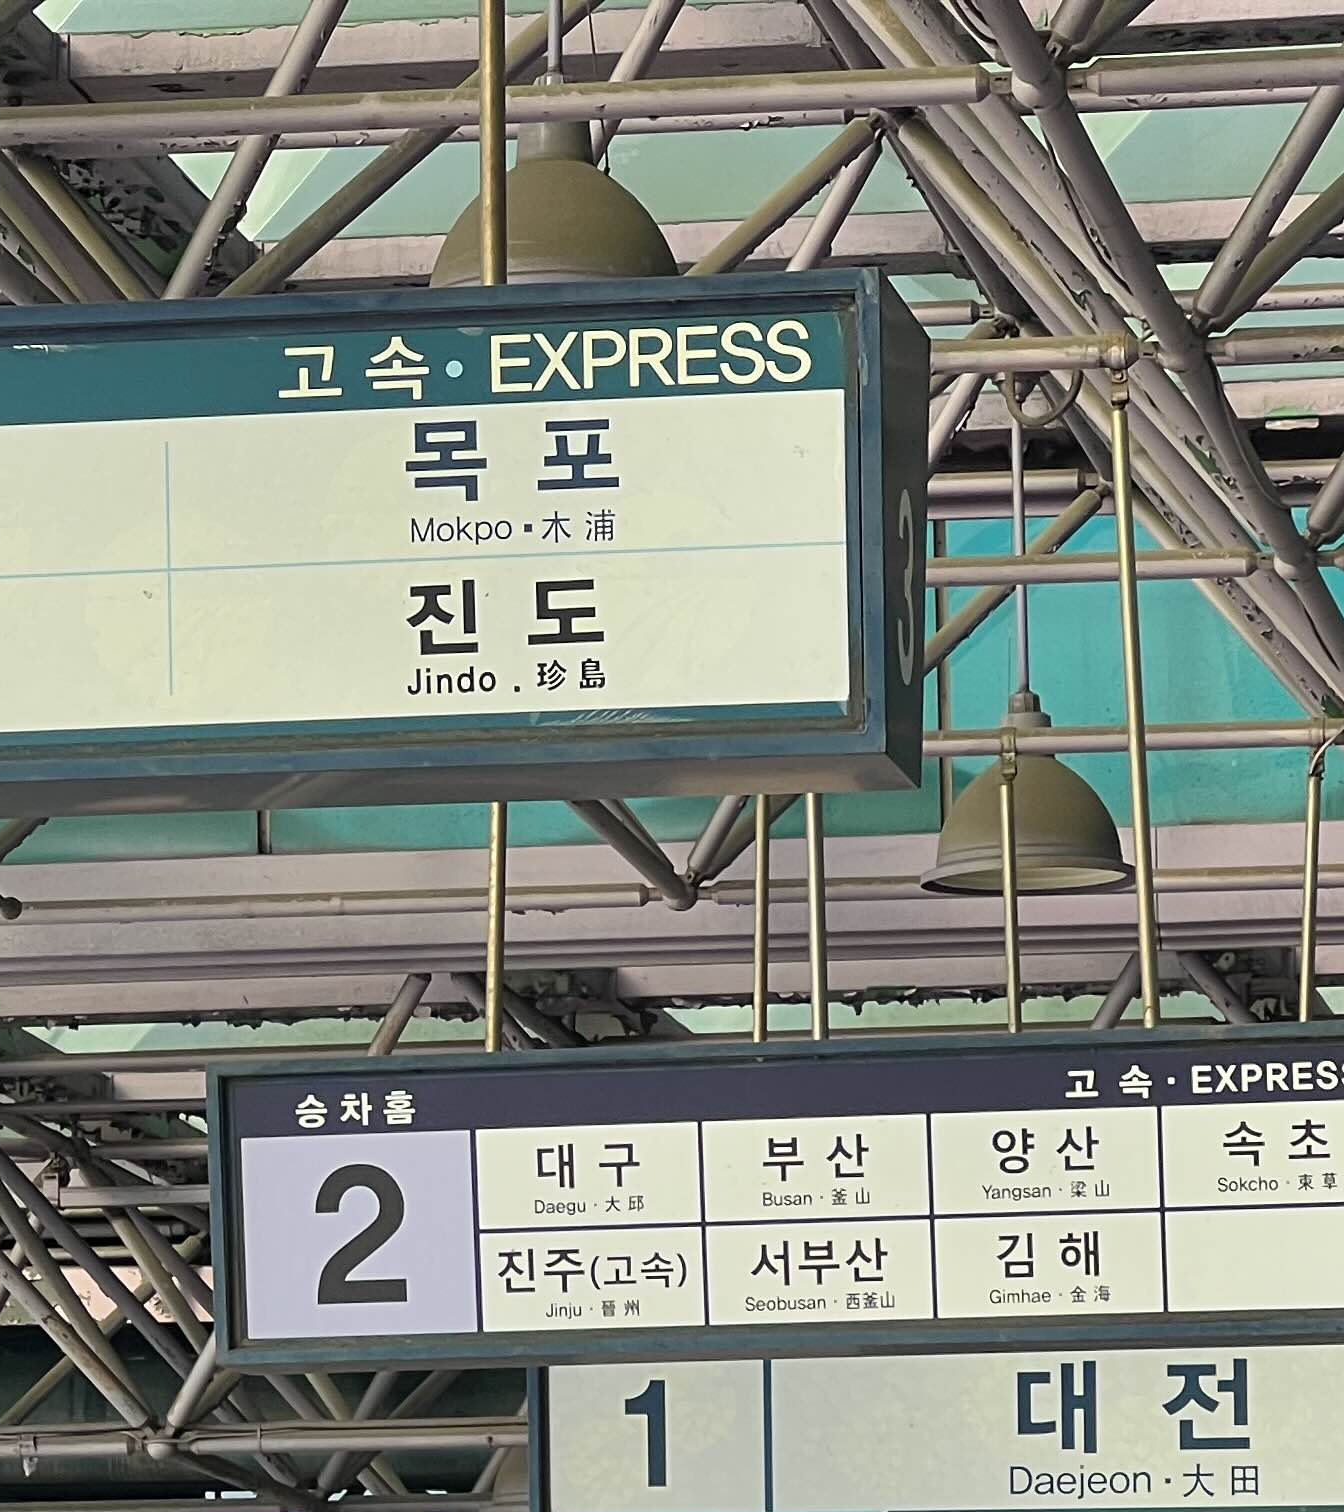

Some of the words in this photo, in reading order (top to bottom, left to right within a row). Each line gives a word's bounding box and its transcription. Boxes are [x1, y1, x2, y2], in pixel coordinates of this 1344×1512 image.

[489, 320, 812, 394] EXPRESS
[411, 516, 512, 545] Mokpo
[407, 666, 496, 695] Jindo
[294, 1089, 417, 1129] 승차홈
[982, 1183, 1052, 1201] Yangsan
[1217, 1176, 1279, 1192] Sokcho
[534, 1199, 586, 1215] Daegu
[762, 1191, 813, 1207] Busan
[314, 1163, 408, 1305] 2
[498, 1248, 687, 1293] 진주(고속)
[750, 1237, 888, 1286] 서부산
[545, 1303, 582, 1319] Jinju
[745, 1295, 827, 1313] Seobusan
[989, 1288, 1052, 1306] Gimhae
[623, 1379, 669, 1488] 1
[1008, 1463, 1153, 1500] Daejeon
